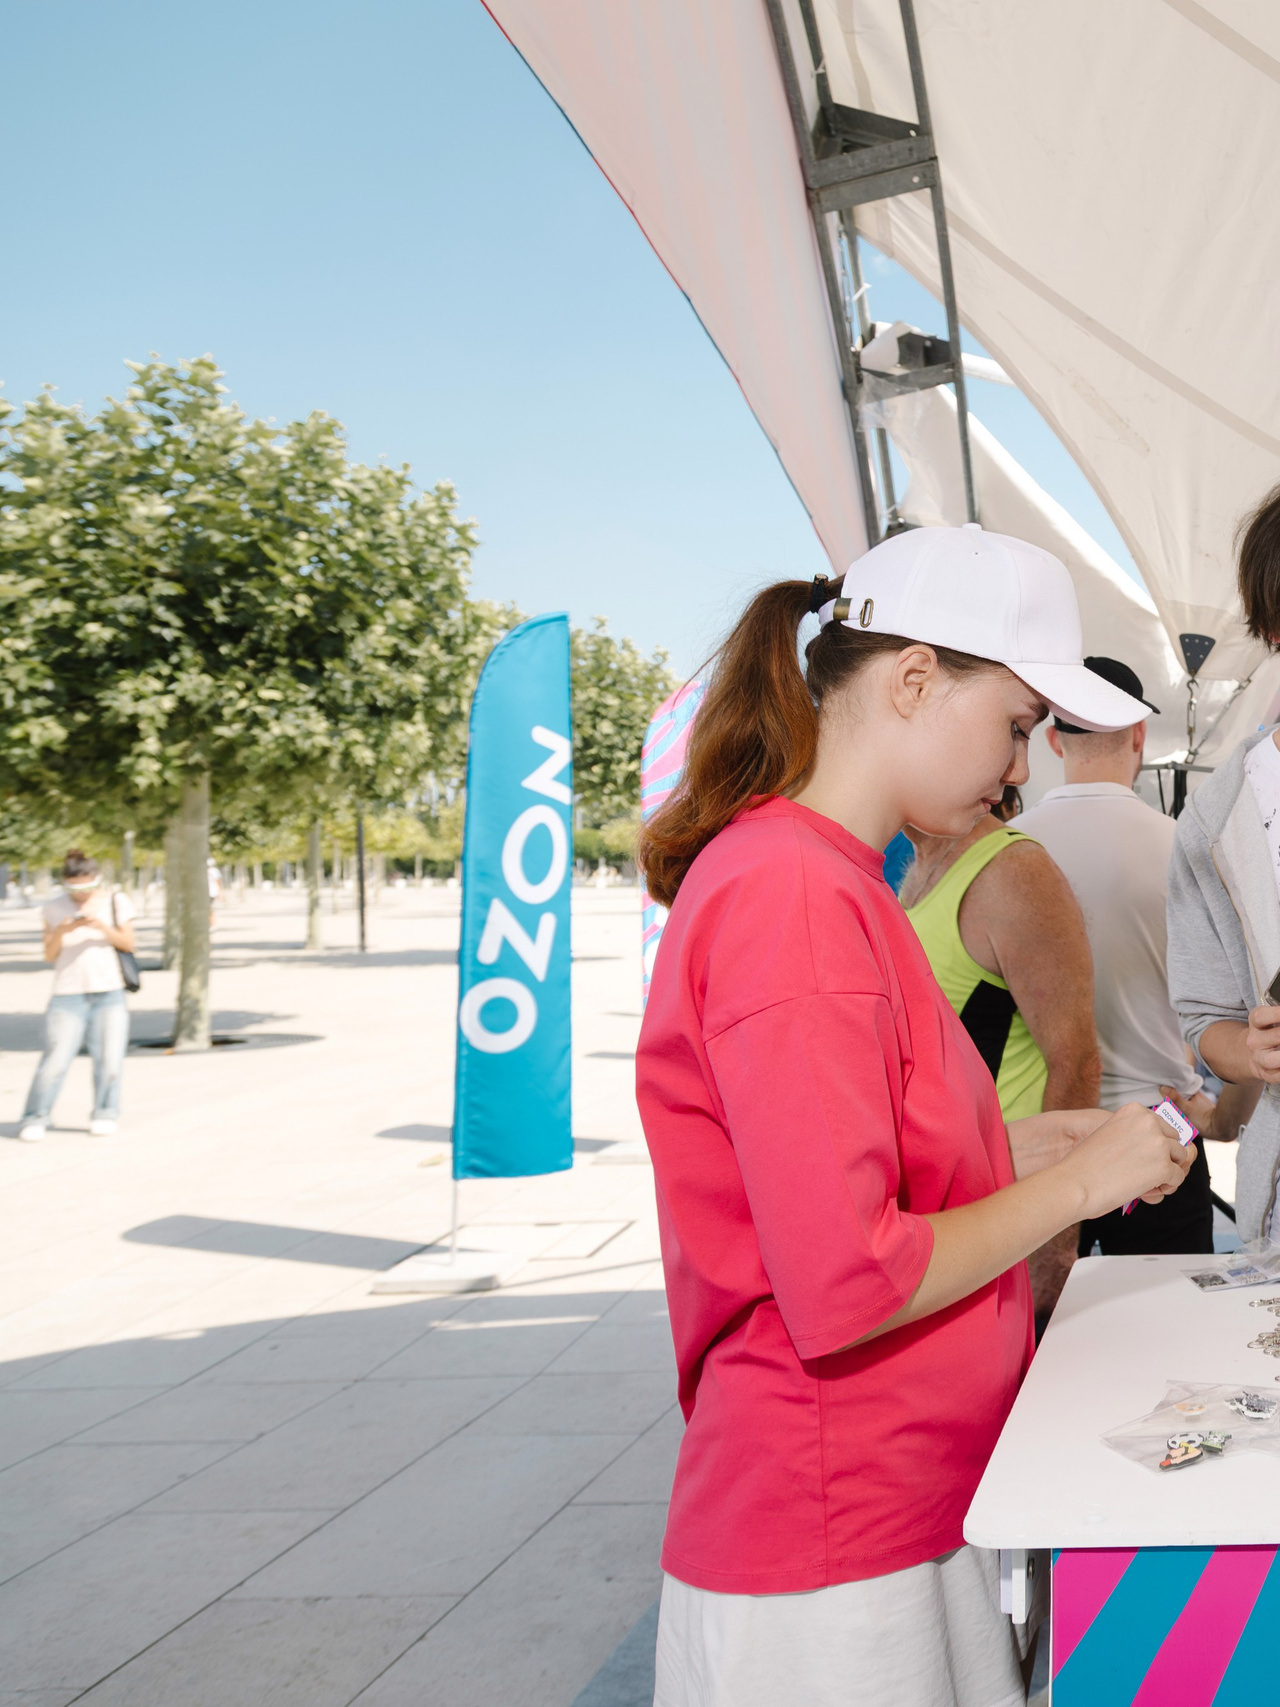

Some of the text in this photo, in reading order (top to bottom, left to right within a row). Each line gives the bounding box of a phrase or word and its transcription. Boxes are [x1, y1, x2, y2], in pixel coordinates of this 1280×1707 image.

[459, 725, 572, 1054] OZON
[1162, 1109, 1174, 1123] OZON
[1178, 1125, 1184, 1133] FC
